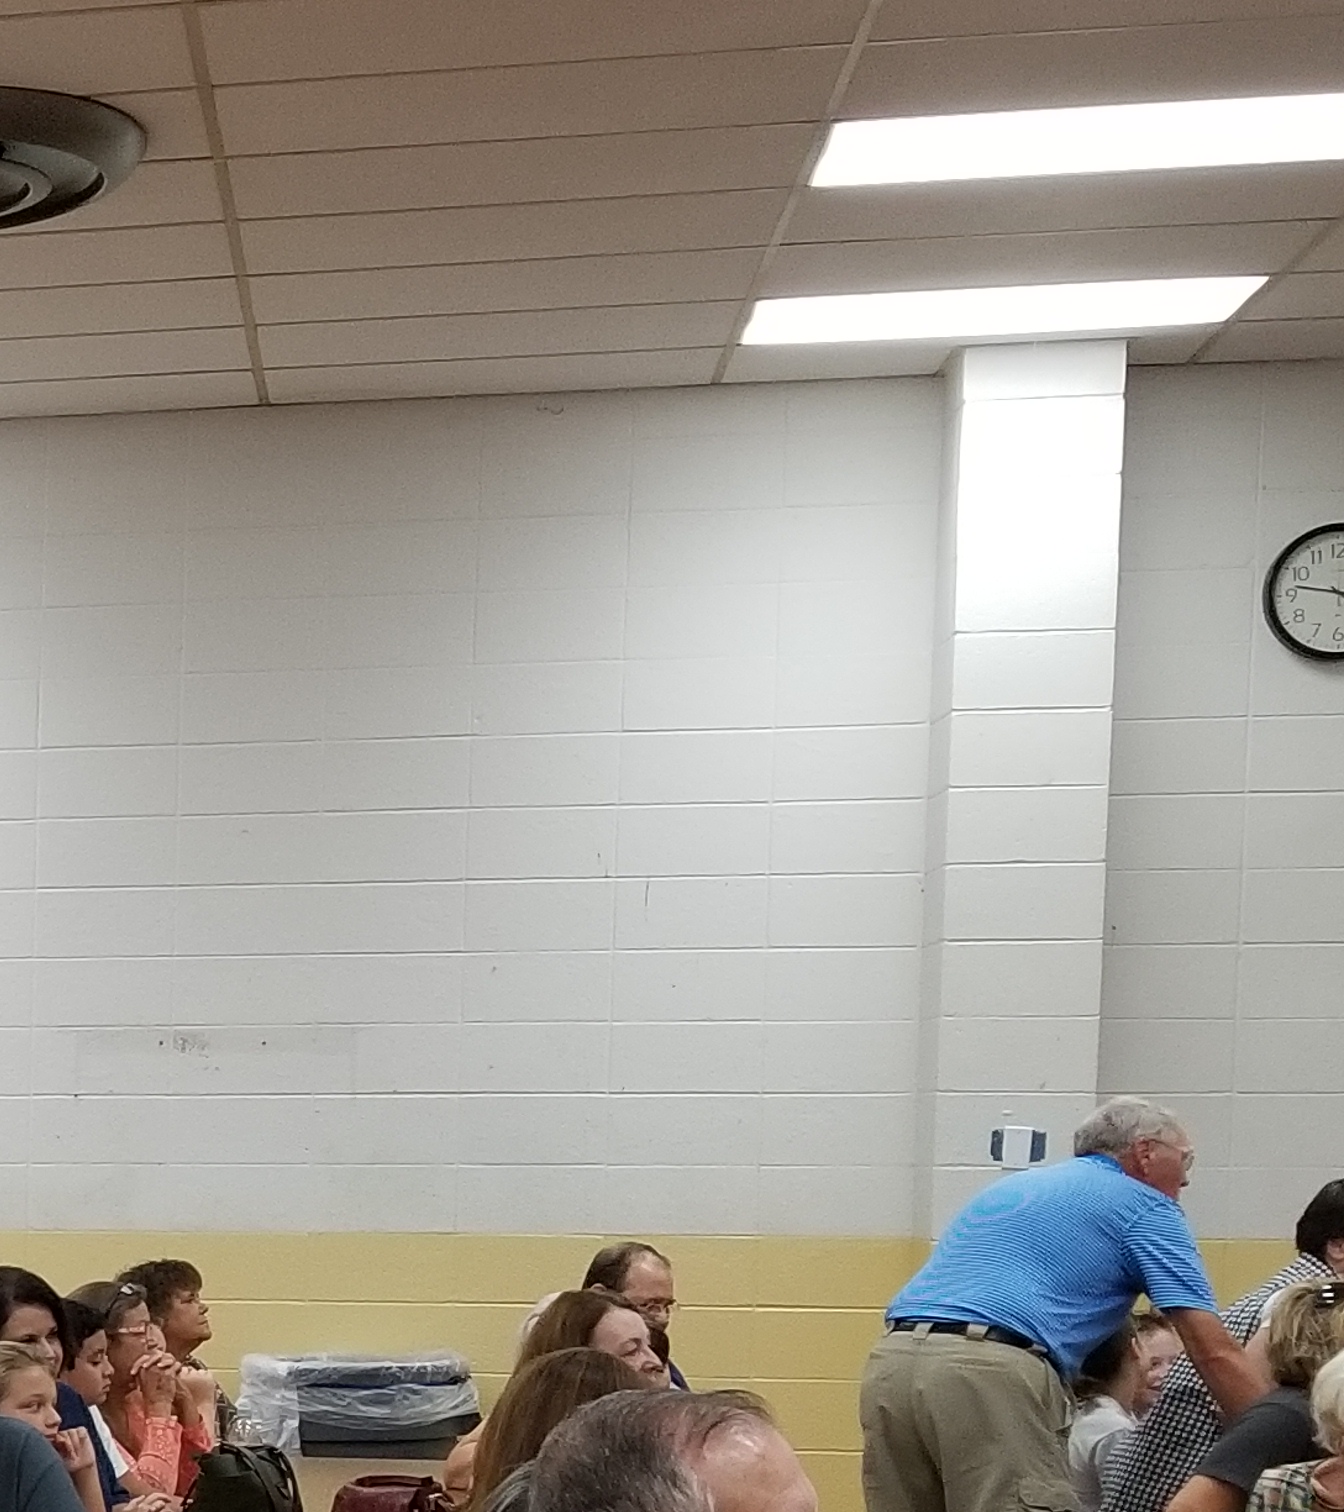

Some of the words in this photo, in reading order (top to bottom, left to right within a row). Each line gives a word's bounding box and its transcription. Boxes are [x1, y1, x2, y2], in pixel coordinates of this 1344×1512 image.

[1311, 550, 1322, 564] 11
[1292, 566, 1310, 582] 10
[1286, 588, 1298, 603] 9
[1293, 609, 1305, 623] 8
[1311, 623, 1322, 638] 7
[1333, 627, 1344, 642] 6
